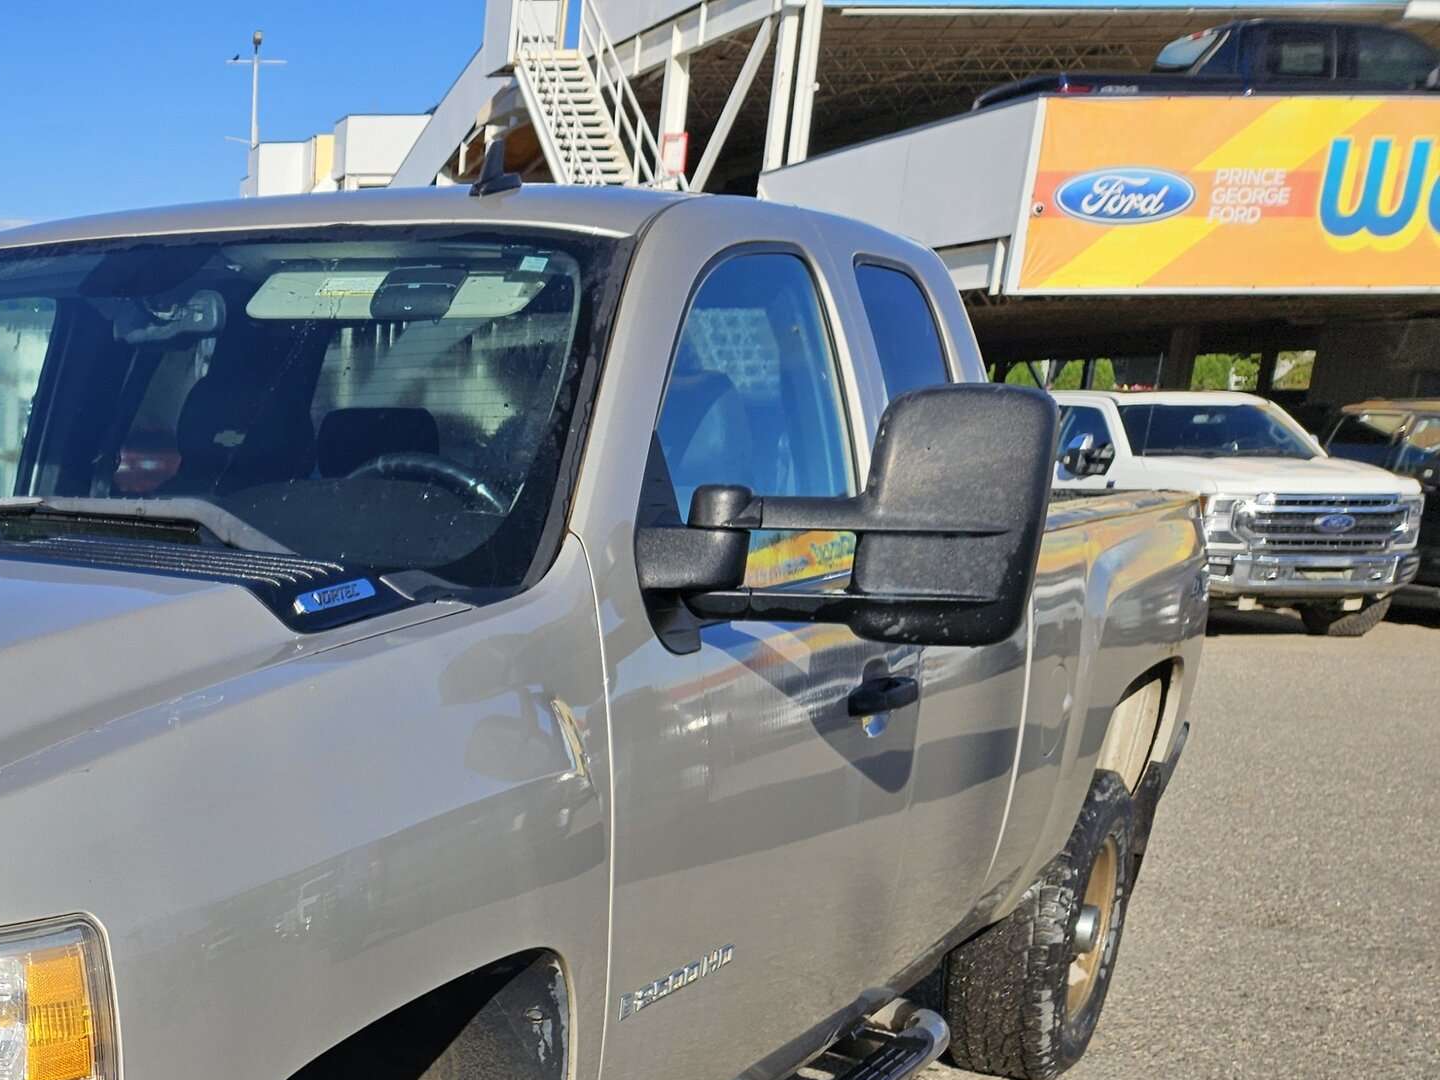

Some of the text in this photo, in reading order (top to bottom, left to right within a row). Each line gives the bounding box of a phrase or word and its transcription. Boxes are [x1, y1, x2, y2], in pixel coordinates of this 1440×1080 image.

[1213, 167, 1287, 186] PRINCE
[1080, 175, 1170, 216] Ford
[1211, 186, 1291, 205] GEORGE
[1319, 137, 1440, 237] W
[1206, 205, 1262, 225] FORD
